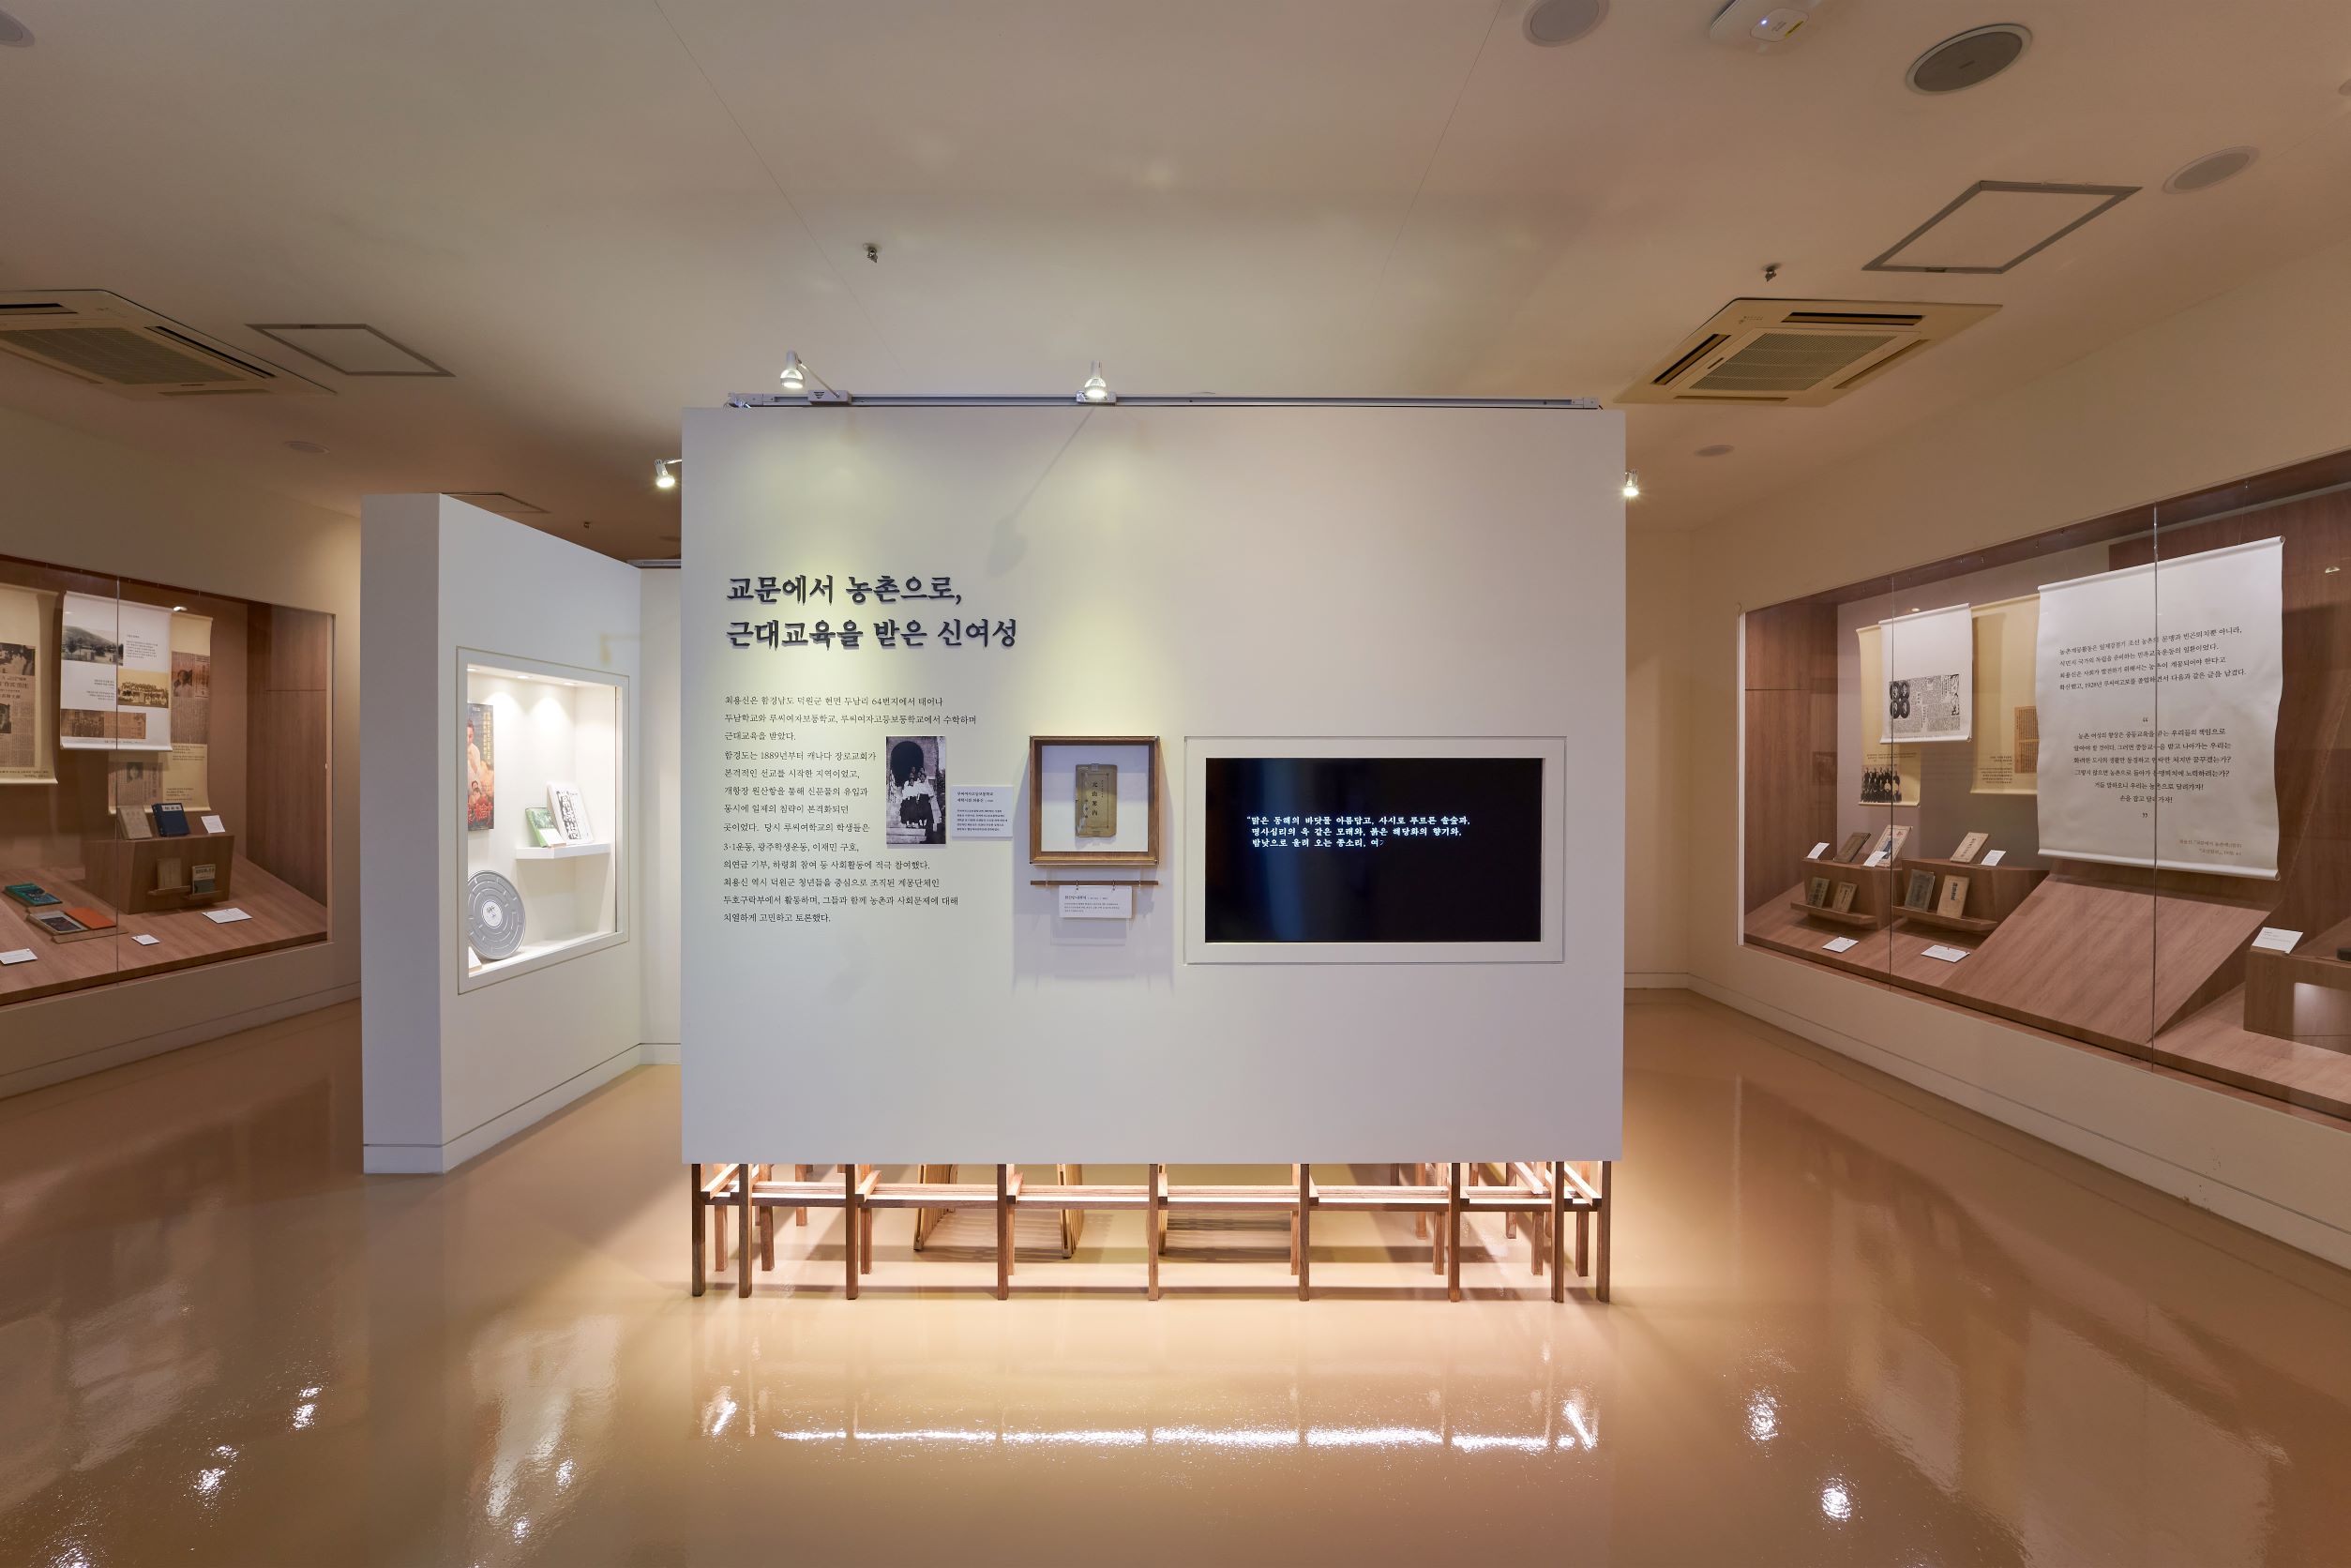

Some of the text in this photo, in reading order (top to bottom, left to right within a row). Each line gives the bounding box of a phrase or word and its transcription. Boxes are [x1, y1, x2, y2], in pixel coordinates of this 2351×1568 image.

[726, 575, 961, 606] 교문에서 농촌으로,
[726, 619, 1016, 651] 근대교육을 받은 신여성
[2184, 643, 2219, 653] 일환이었다.
[2224, 669, 2246, 677] 남겼다.
[725, 696, 942, 706] 최용신은 함경남도 덕원군 현면 두남리 64번지에서 태어나
[725, 714, 975, 725] 두남학교와 루씨여자보통학교, 루씨여자고등보통학교에서 수학하며
[725, 731, 795, 740] 근대교육을 받았다.
[725, 751, 876, 761] 함경도는 1889년부터 캐나다 장로교회가
[725, 769, 859, 778] 본격적인 선교를 시작한 지역이었고,
[725, 787, 867, 796] 개항장 원산항을 통해 신문물의 유입과
[724, 805, 848, 814] 동시에 일제의 침략이 본격화되던
[1273, 816, 1299, 824] 동해의
[1305, 816, 1332, 825] 바닷물
[1336, 816, 1374, 825] 아름답고,
[1379, 816, 1406, 824] 사시로
[1440, 816, 1469, 824] 솔숲과,
[724, 823, 869, 832] 곳이었다. 당시 루씨여학교의 학생들은
[1252, 827, 1461, 836] 명사십리의 옥 같은 모래와, 붉은 해당화의 향기와,
[1253, 838, 1288, 847] 밤낮으로
[1292, 838, 1308, 847] 울려
[1314, 838, 1332, 847] 오는
[1336, 838, 1365, 847] 종소리,
[724, 843, 859, 852] 3·1운동, 광주학생운동, 이재민 구호,
[724, 860, 929, 869] 의연금 기부, 하령회 참여 등 사회활동에 적극 참여했다.
[724, 878, 939, 887] 최용신 역시 덕원군 청년들을 중심으로 조직된 계몽단체인
[724, 896, 780, 904] 두호구락부에서
[785, 896, 820, 905] 활동하며,
[822, 897, 848, 905] 그들과
[870, 897, 893, 905] 농촌과
[897, 897, 938, 905] 사회문제에
[942, 897, 957, 905] 대해
[724, 913, 830, 922] 치열하게 고민하고 토론했다.
